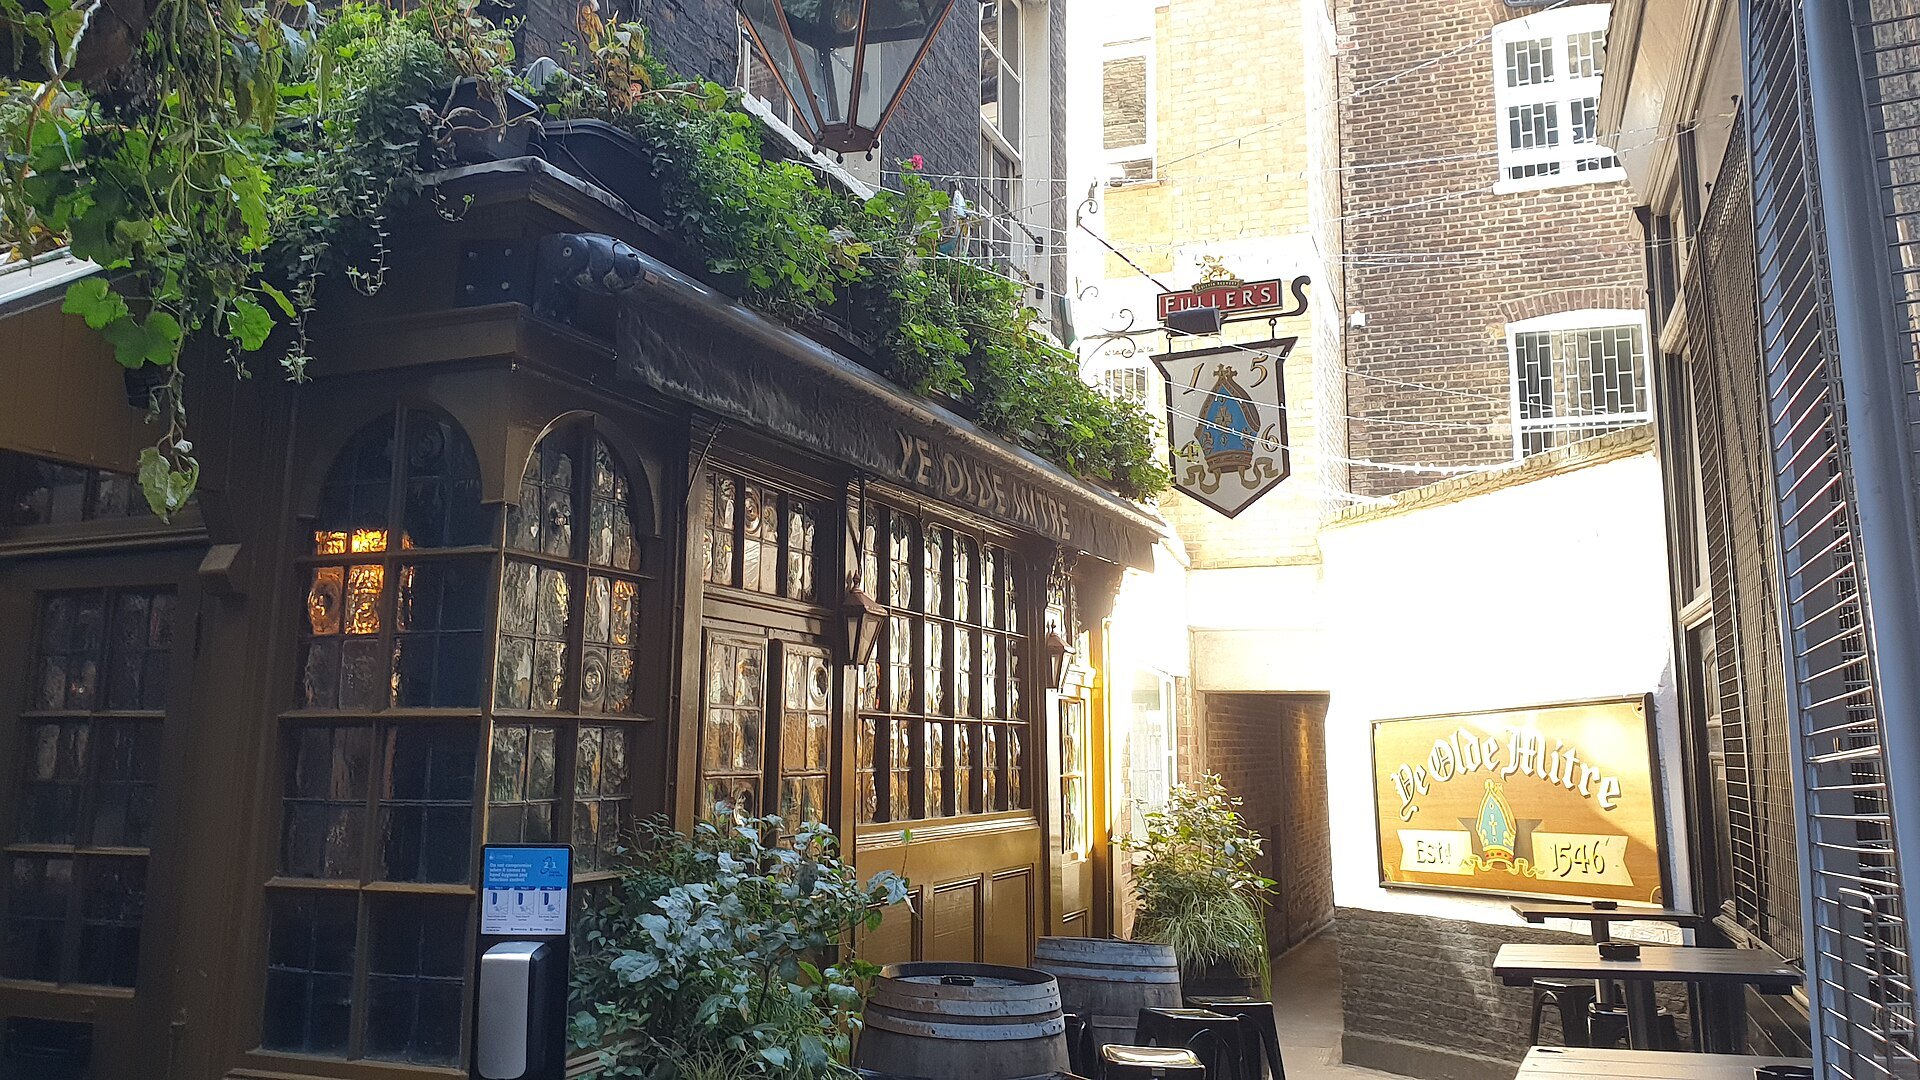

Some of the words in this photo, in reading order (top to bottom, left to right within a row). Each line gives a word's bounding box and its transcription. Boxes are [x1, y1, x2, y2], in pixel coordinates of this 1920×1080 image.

[1165, 286, 1271, 314] FULLER'S
[895, 429, 932, 486] YE
[942, 452, 1007, 515] OLDE
[1012, 481, 1071, 541] MITRE
[1390, 763, 1430, 822] Ye
[1428, 727, 1500, 783] Olde
[1501, 727, 1622, 812] Mitre
[1550, 839, 1606, 878] 1546
